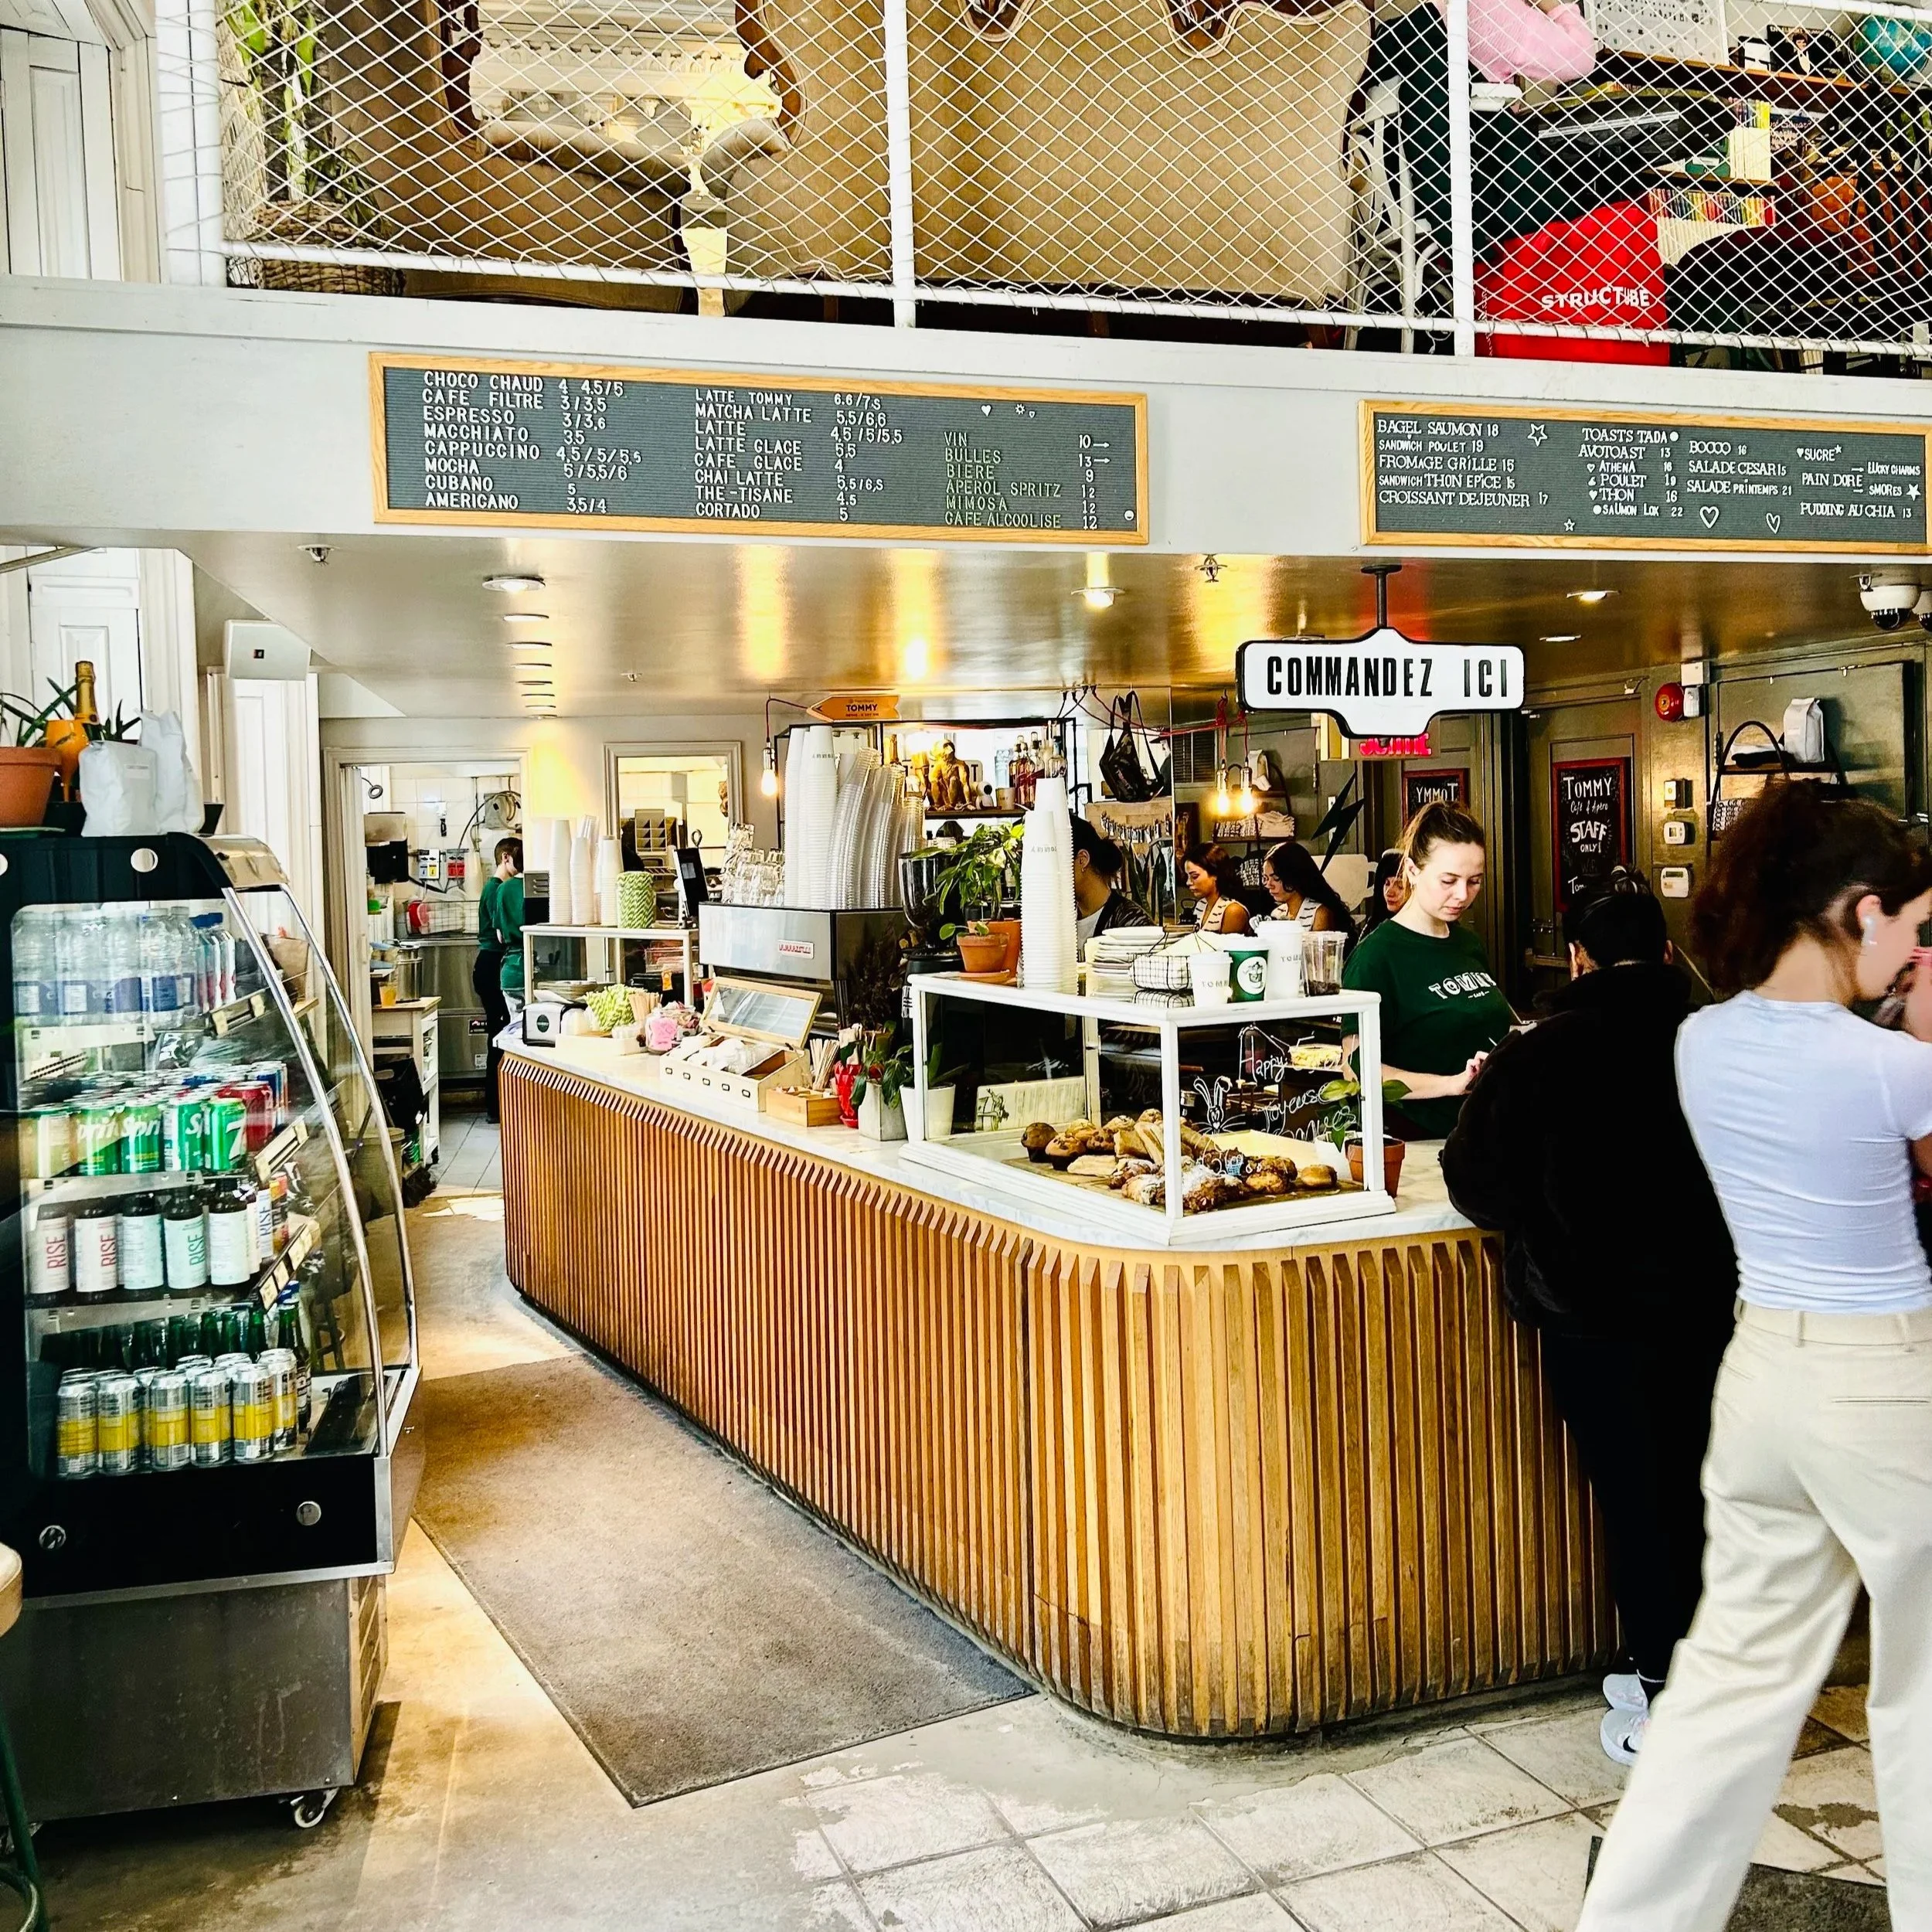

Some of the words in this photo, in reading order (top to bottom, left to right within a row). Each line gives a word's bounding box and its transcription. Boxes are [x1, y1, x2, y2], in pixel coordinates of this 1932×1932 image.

[424, 371, 478, 389] CHOCO
[489, 375, 543, 392] CHAUD
[423, 389, 470, 406] CAFE
[489, 392, 543, 410] FILTRE
[696, 389, 735, 403] LATTE
[749, 392, 792, 406] TOMMY
[423, 406, 515, 424] ESPRESSO
[696, 403, 753, 420] MATCHA
[762, 406, 811, 423] LATTE
[424, 423, 529, 442] MACCHIATO
[563, 430, 585, 445] 3.5
[696, 420, 746, 436] LATTE
[1377, 420, 1421, 434] BAGEL
[1428, 422, 1482, 436] SAUMON
[1488, 424, 1499, 437] 18
[1582, 428, 1633, 442] TOASTS
[1637, 430, 1667, 444] TADA
[696, 436, 746, 452] LATTE
[754, 440, 801, 455] GLACE
[944, 432, 966, 446] VIN
[1079, 434, 1091, 448] 10
[1379, 440, 1422, 451] SANDWICH
[1428, 440, 1466, 453] POULET
[1472, 440, 1484, 453] 19
[425, 440, 540, 459] CAPPUCCINO
[945, 447, 1001, 464] BULLES
[1079, 454, 1092, 468] 13
[1578, 444, 1645, 459] AVOTOAST
[1660, 447, 1671, 458] 13
[1804, 448, 1835, 461] SUCRE
[425, 457, 479, 474] MOCHA
[695, 453, 736, 468] CAFE
[754, 456, 802, 471] GLACE
[835, 459, 843, 473] 4
[1379, 454, 1443, 470] FROMAGE
[1599, 460, 1636, 473] ATHENA
[1689, 460, 1736, 474] SALADE
[1738, 462, 1777, 476] CESAR
[1777, 464, 1787, 476] 15
[1868, 461, 1889, 475] LUCKY
[1890, 464, 1920, 475] CHARMS
[696, 470, 727, 484] CHAI
[736, 471, 784, 487] LATTE
[947, 464, 995, 479] BIERE
[1085, 469, 1094, 482] 9
[1379, 474, 1422, 487] SANDWICH
[1424, 473, 1463, 488] THON
[1506, 476, 1515, 489] 15
[1600, 474, 1647, 488] POULET
[1802, 473, 1829, 486] PAIN
[1833, 474, 1862, 487] DORE
[425, 475, 493, 492] CUBANO
[567, 483, 577, 495] 5
[946, 479, 1001, 495] APEROL
[1010, 482, 1061, 497] SPRITZ
[1082, 485, 1095, 498] 12
[1687, 479, 1730, 494] SALADE
[1782, 485, 1791, 495] 21
[425, 492, 519, 509] AMERICANO
[697, 486, 725, 501] THE
[837, 492, 856, 506] 4.5
[1379, 490, 1455, 505] CROISSANT
[1459, 492, 1530, 507] DEJEUNER
[1539, 492, 1549, 505] 17
[1599, 488, 1634, 502] THON
[1665, 491, 1678, 502] 16
[696, 503, 760, 519] CORTADO
[839, 508, 849, 522] 5
[946, 495, 1007, 511] MIMOSA
[1083, 500, 1096, 514] 12
[1671, 507, 1683, 517] 22
[1800, 502, 1844, 516] PUDDING
[1848, 503, 1863, 516] AU
[1865, 505, 1895, 518] CHIA
[1903, 508, 1912, 519] 13
[945, 512, 981, 526] CAFE
[987, 513, 1061, 528] ALCOOLISE
[1083, 515, 1097, 529] 12
[1267, 656, 1432, 696] COMMANDEZ
[1464, 659, 1507, 697] ICI
[1563, 777, 1612, 800] TOMMY
[1570, 820, 1607, 843] STAFF
[46, 1234, 67, 1270] RISE
[100, 1234, 117, 1267] RISE
[187, 1233, 206, 1267] RISE
